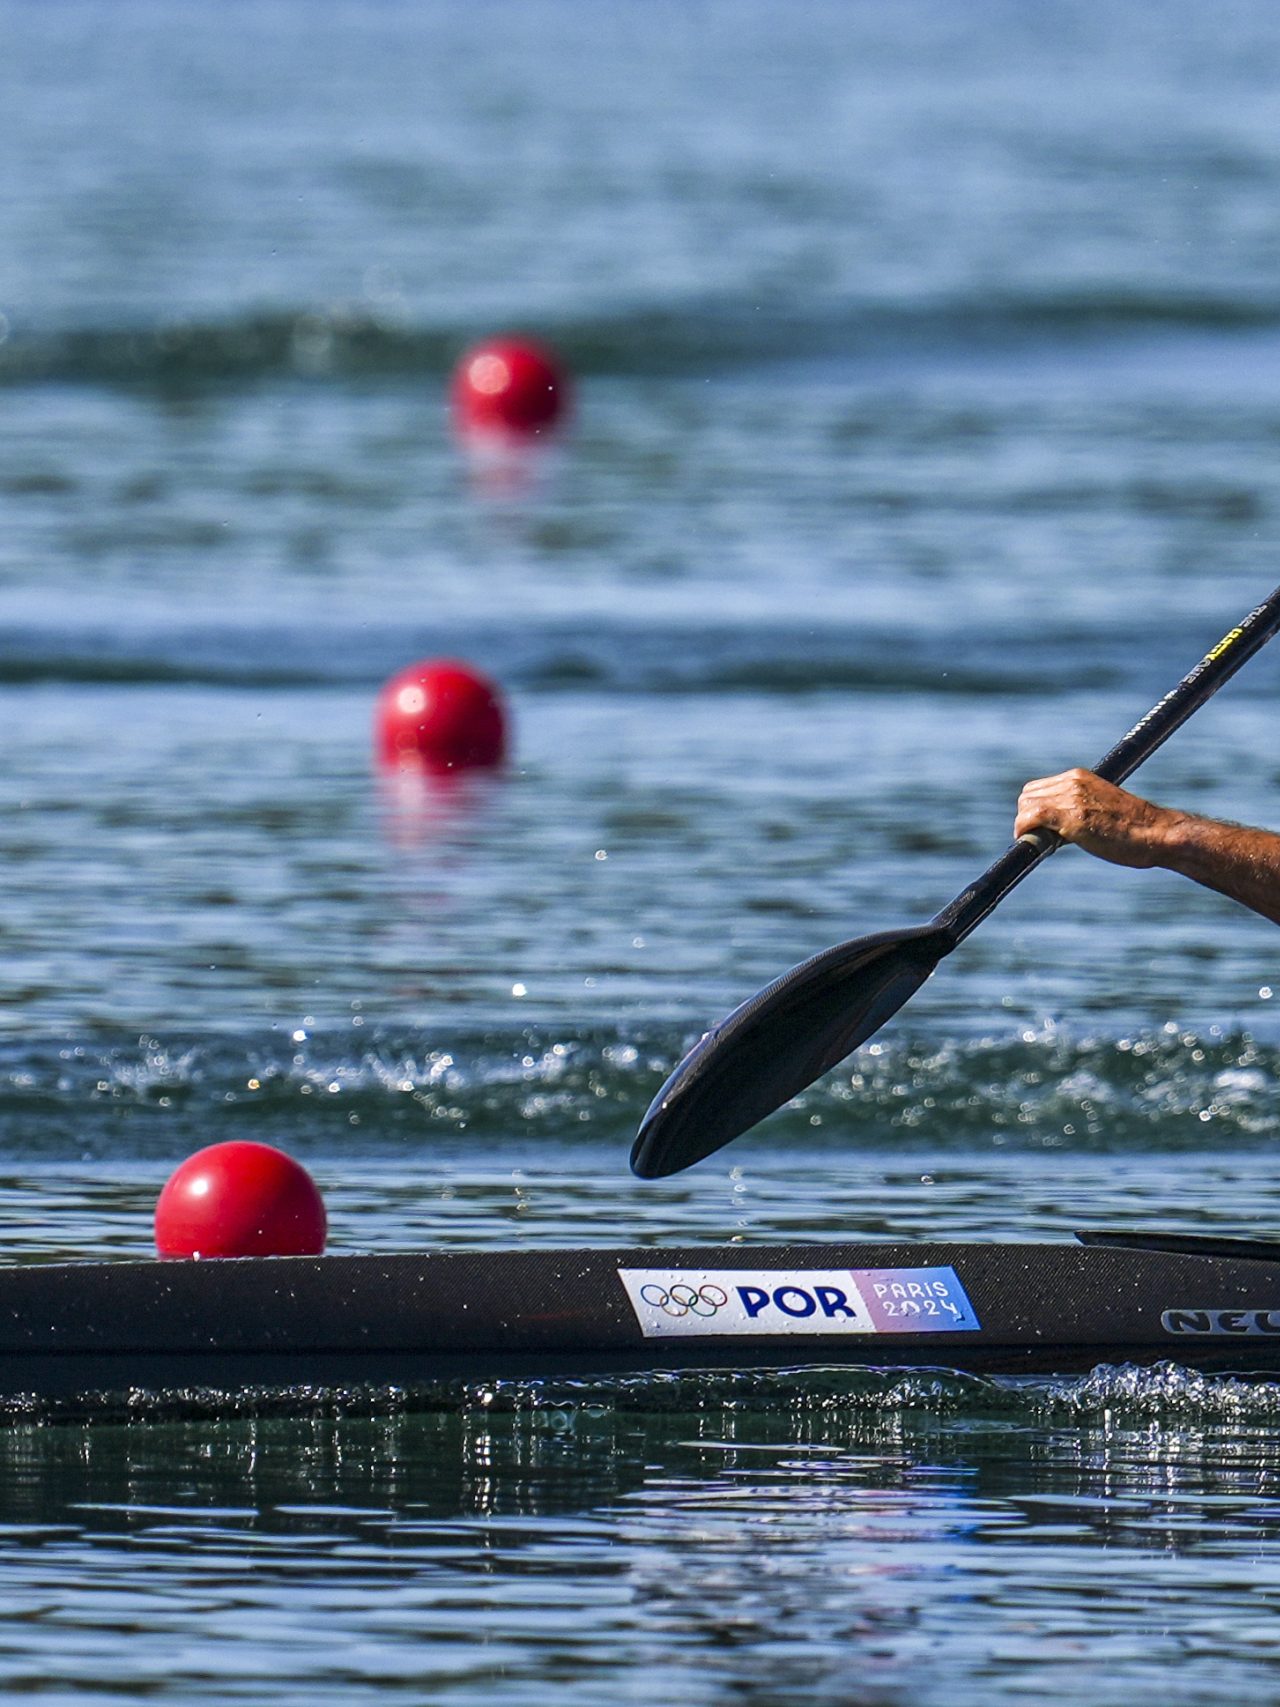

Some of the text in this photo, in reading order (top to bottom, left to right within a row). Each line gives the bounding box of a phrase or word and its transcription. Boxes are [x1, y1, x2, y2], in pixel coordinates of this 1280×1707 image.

[873, 1281, 949, 1299] PARIS
[736, 1286, 858, 1318] POR
[882, 1299, 959, 1317] 2024
